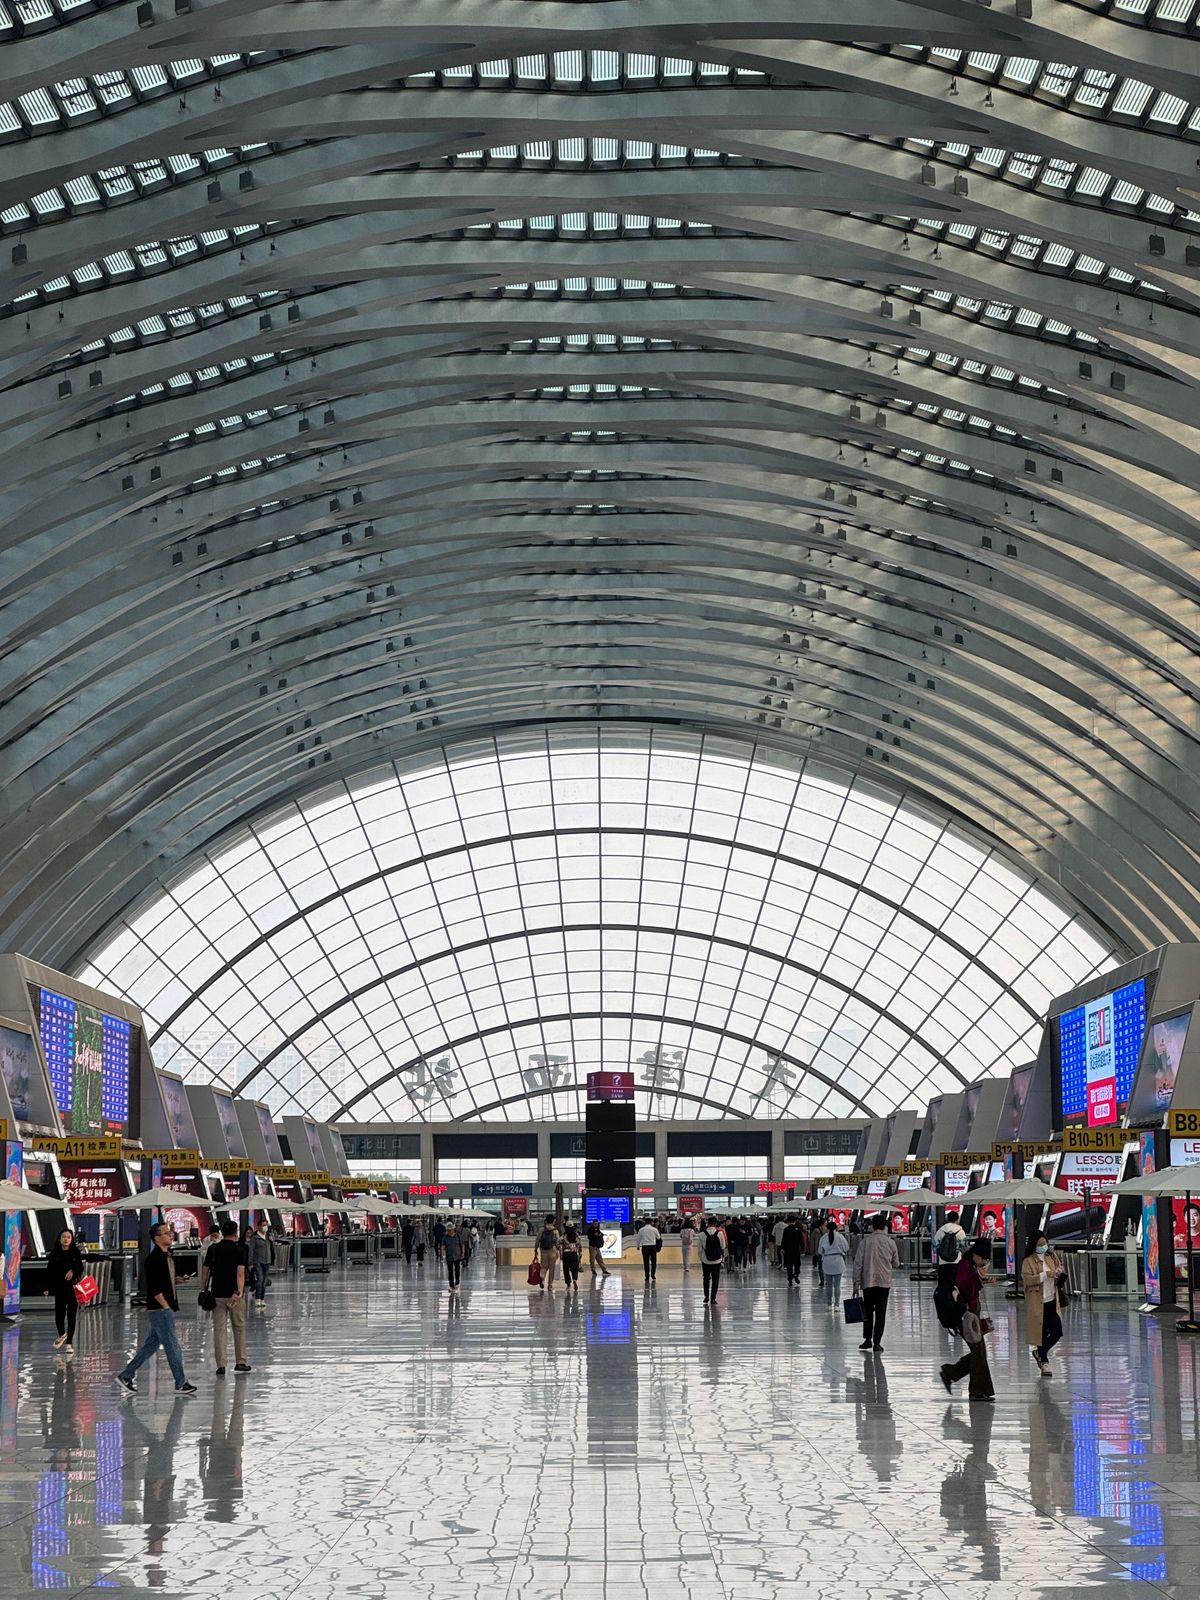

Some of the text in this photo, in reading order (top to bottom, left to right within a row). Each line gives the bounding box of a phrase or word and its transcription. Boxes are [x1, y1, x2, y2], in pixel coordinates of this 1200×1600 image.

[1176, 1113, 1200, 1131] B8
[361, 1138, 400, 1149] 北出口
[1069, 1132, 1115, 1147] B10-B11
[88, 1142, 117, 1150] 检票口
[995, 1145, 1034, 1158] B12B13
[130, 1153, 169, 1165] A113
[944, 1155, 977, 1166] B14-B15
[1075, 1156, 1114, 1165] LESSO
[200, 1162, 228, 1174] 14-A15
[872, 1169, 899, 1177] B18-B19
